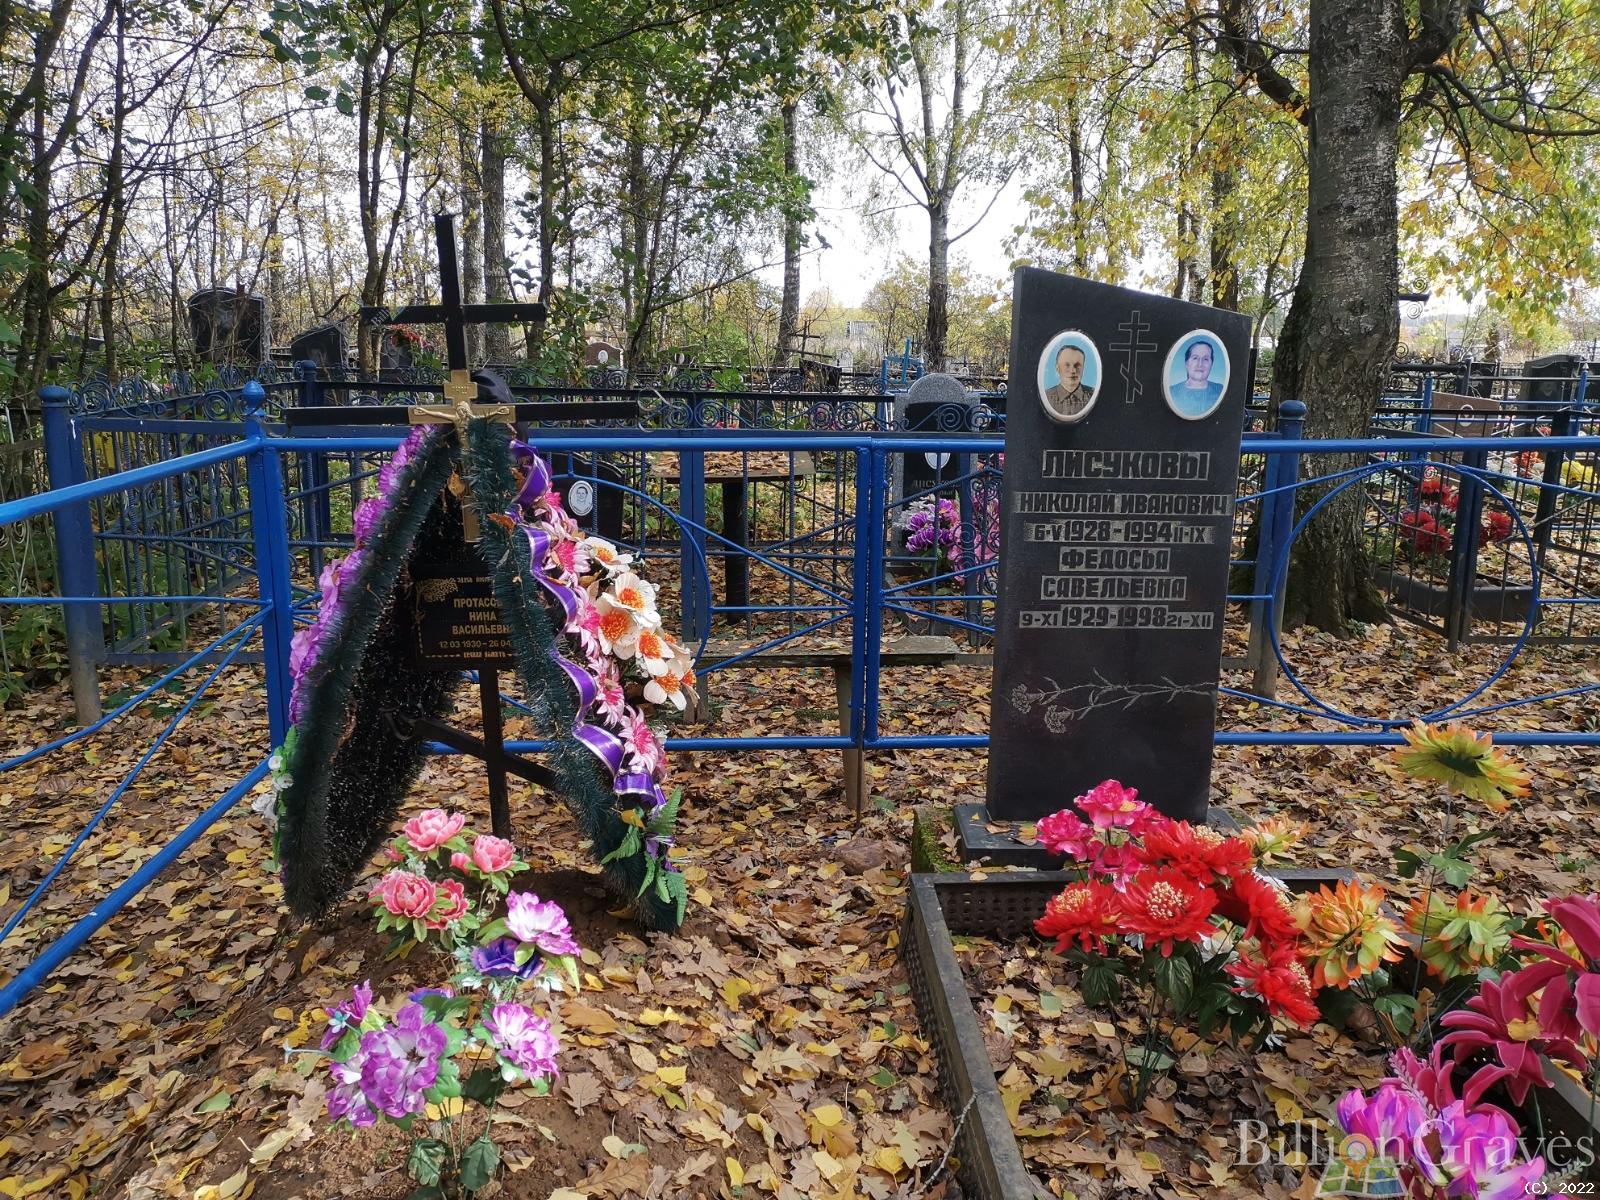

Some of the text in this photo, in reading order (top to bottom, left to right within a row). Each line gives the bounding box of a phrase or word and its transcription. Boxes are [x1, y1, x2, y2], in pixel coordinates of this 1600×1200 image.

[1042, 451, 1209, 479] ЛИСУКОВЫ
[1119, 494, 1227, 514] ИВАНОВИЧ
[1060, 549, 1170, 570] ФЕДОСЬЯ
[1043, 577, 1186, 599] САВЕЛЬЕВНА
[468, 611, 497, 621] НИНА
